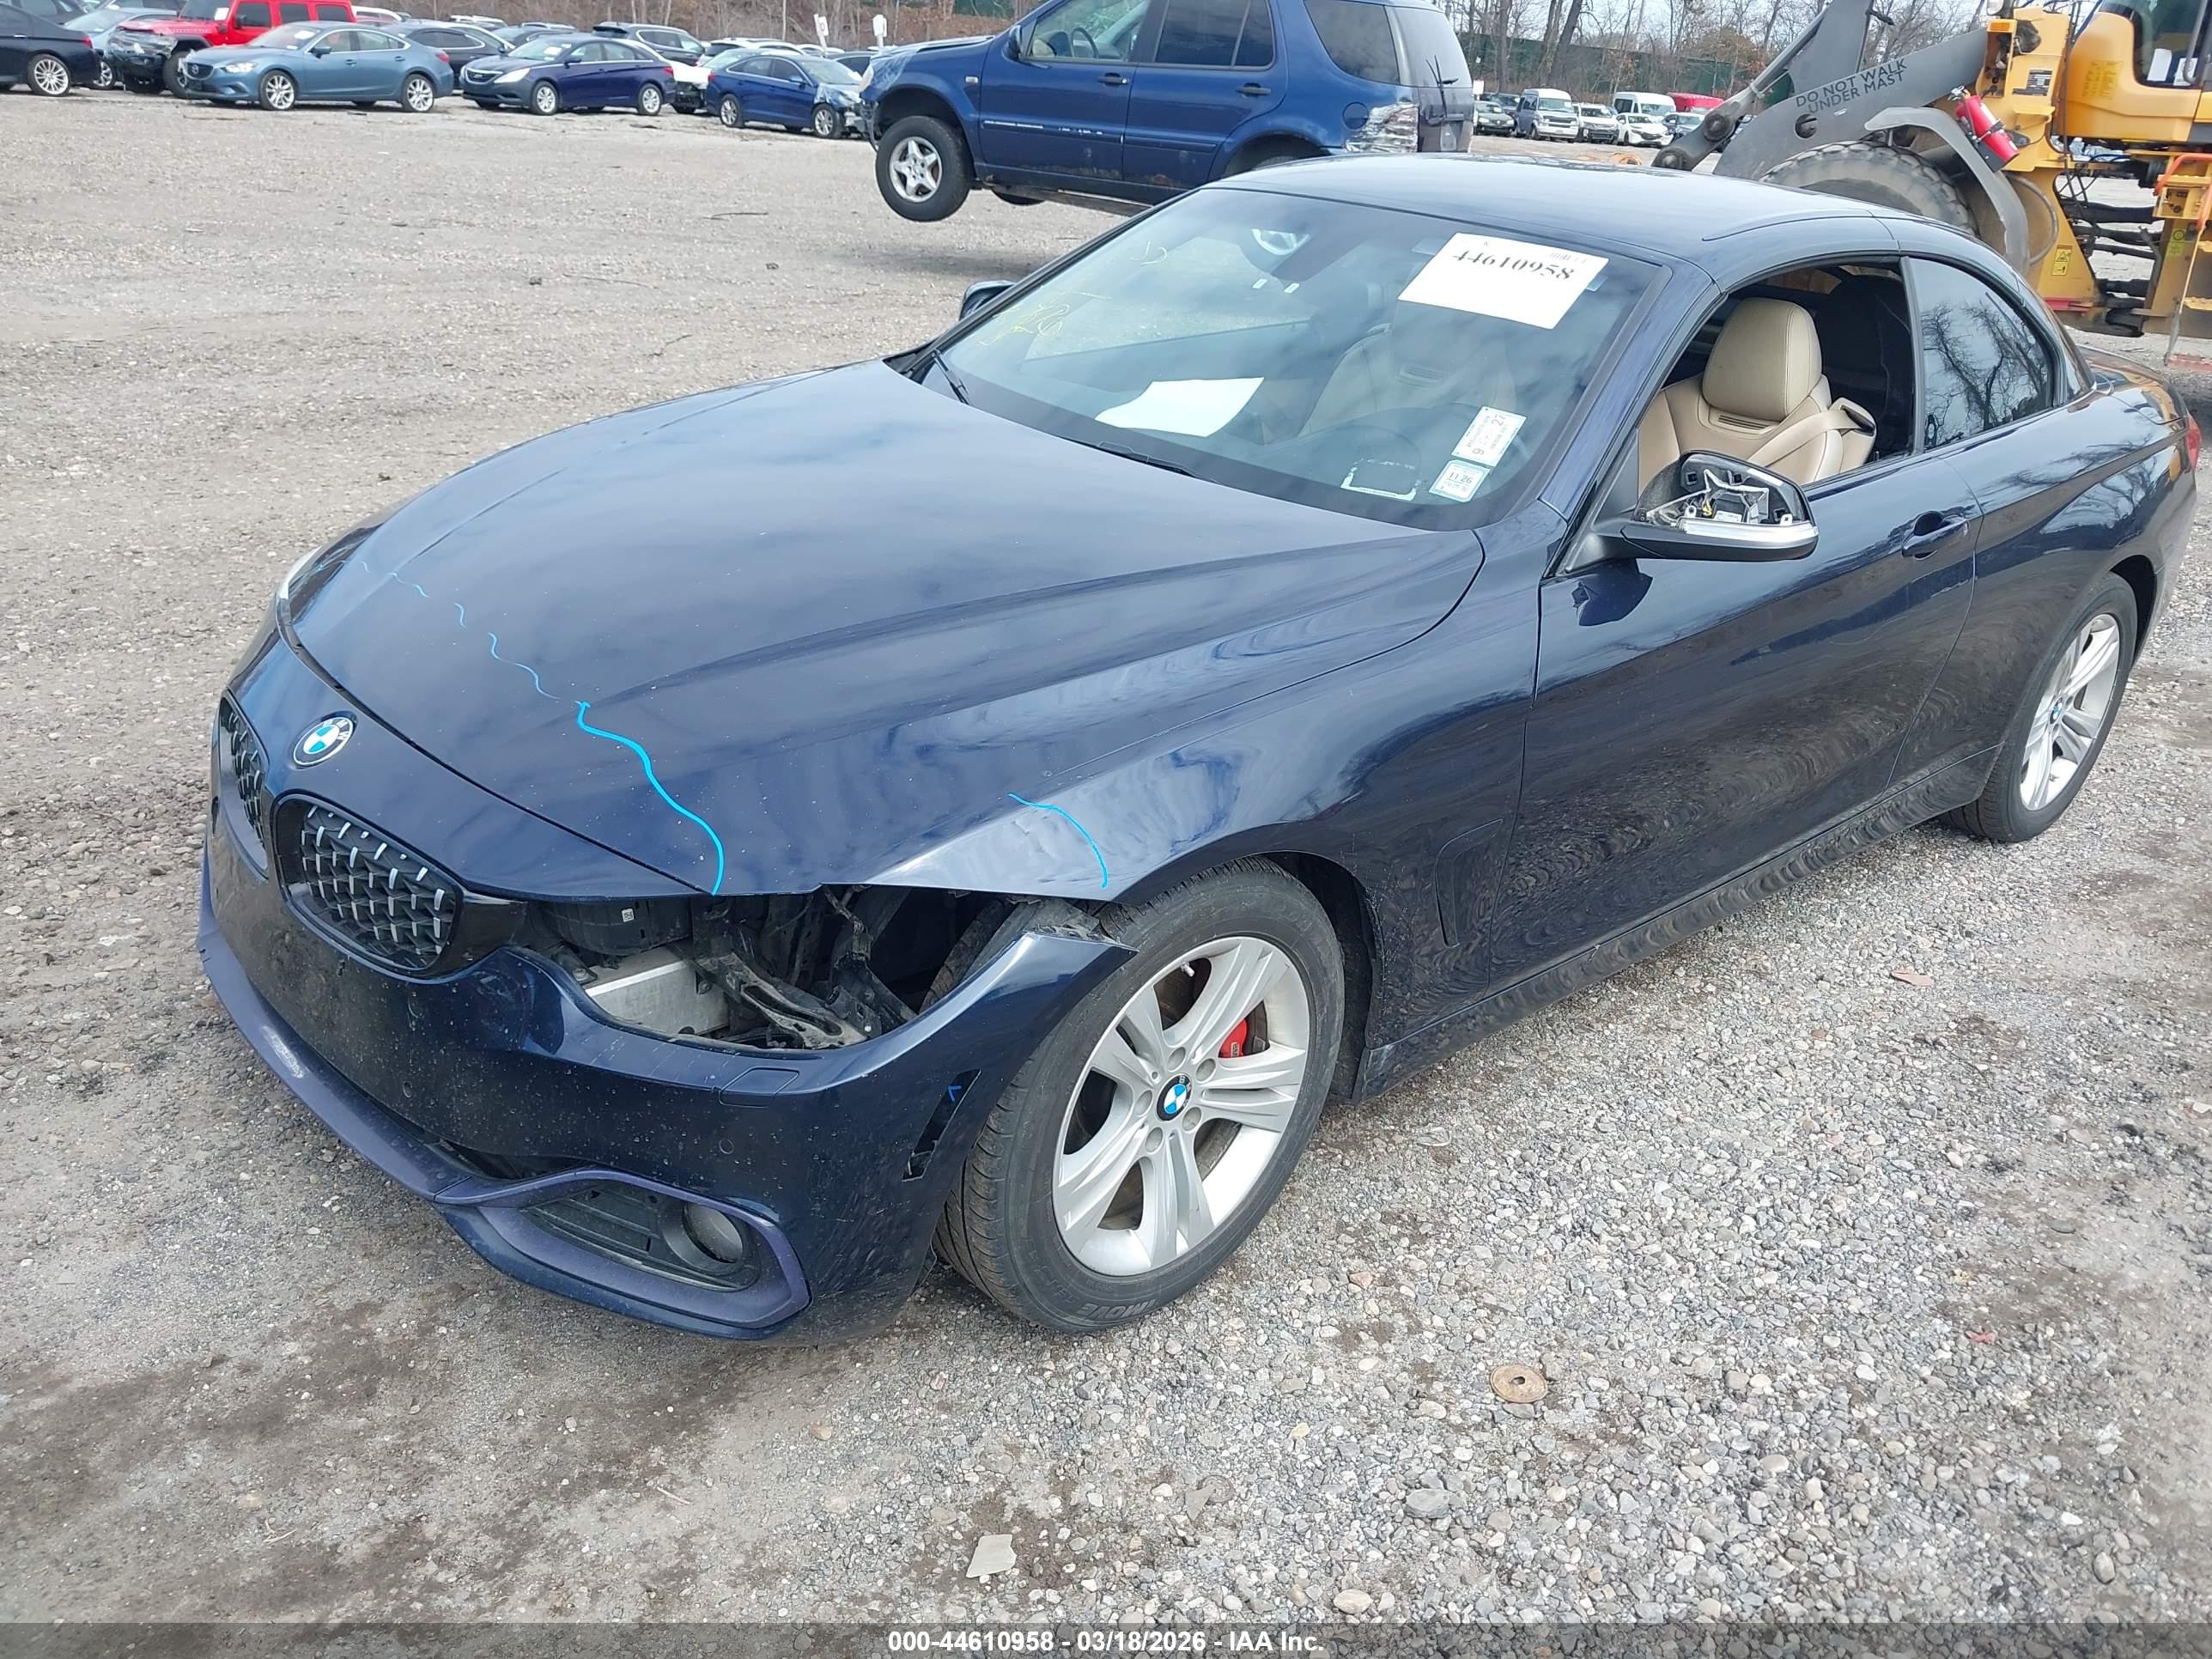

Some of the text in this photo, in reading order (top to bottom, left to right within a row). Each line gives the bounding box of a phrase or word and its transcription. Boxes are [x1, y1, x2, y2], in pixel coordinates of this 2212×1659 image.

[1796, 58, 1907, 107] DO NOT WALK
[1808, 70, 1904, 113] UNDER MAST
[1452, 249, 1575, 281] 44610958
